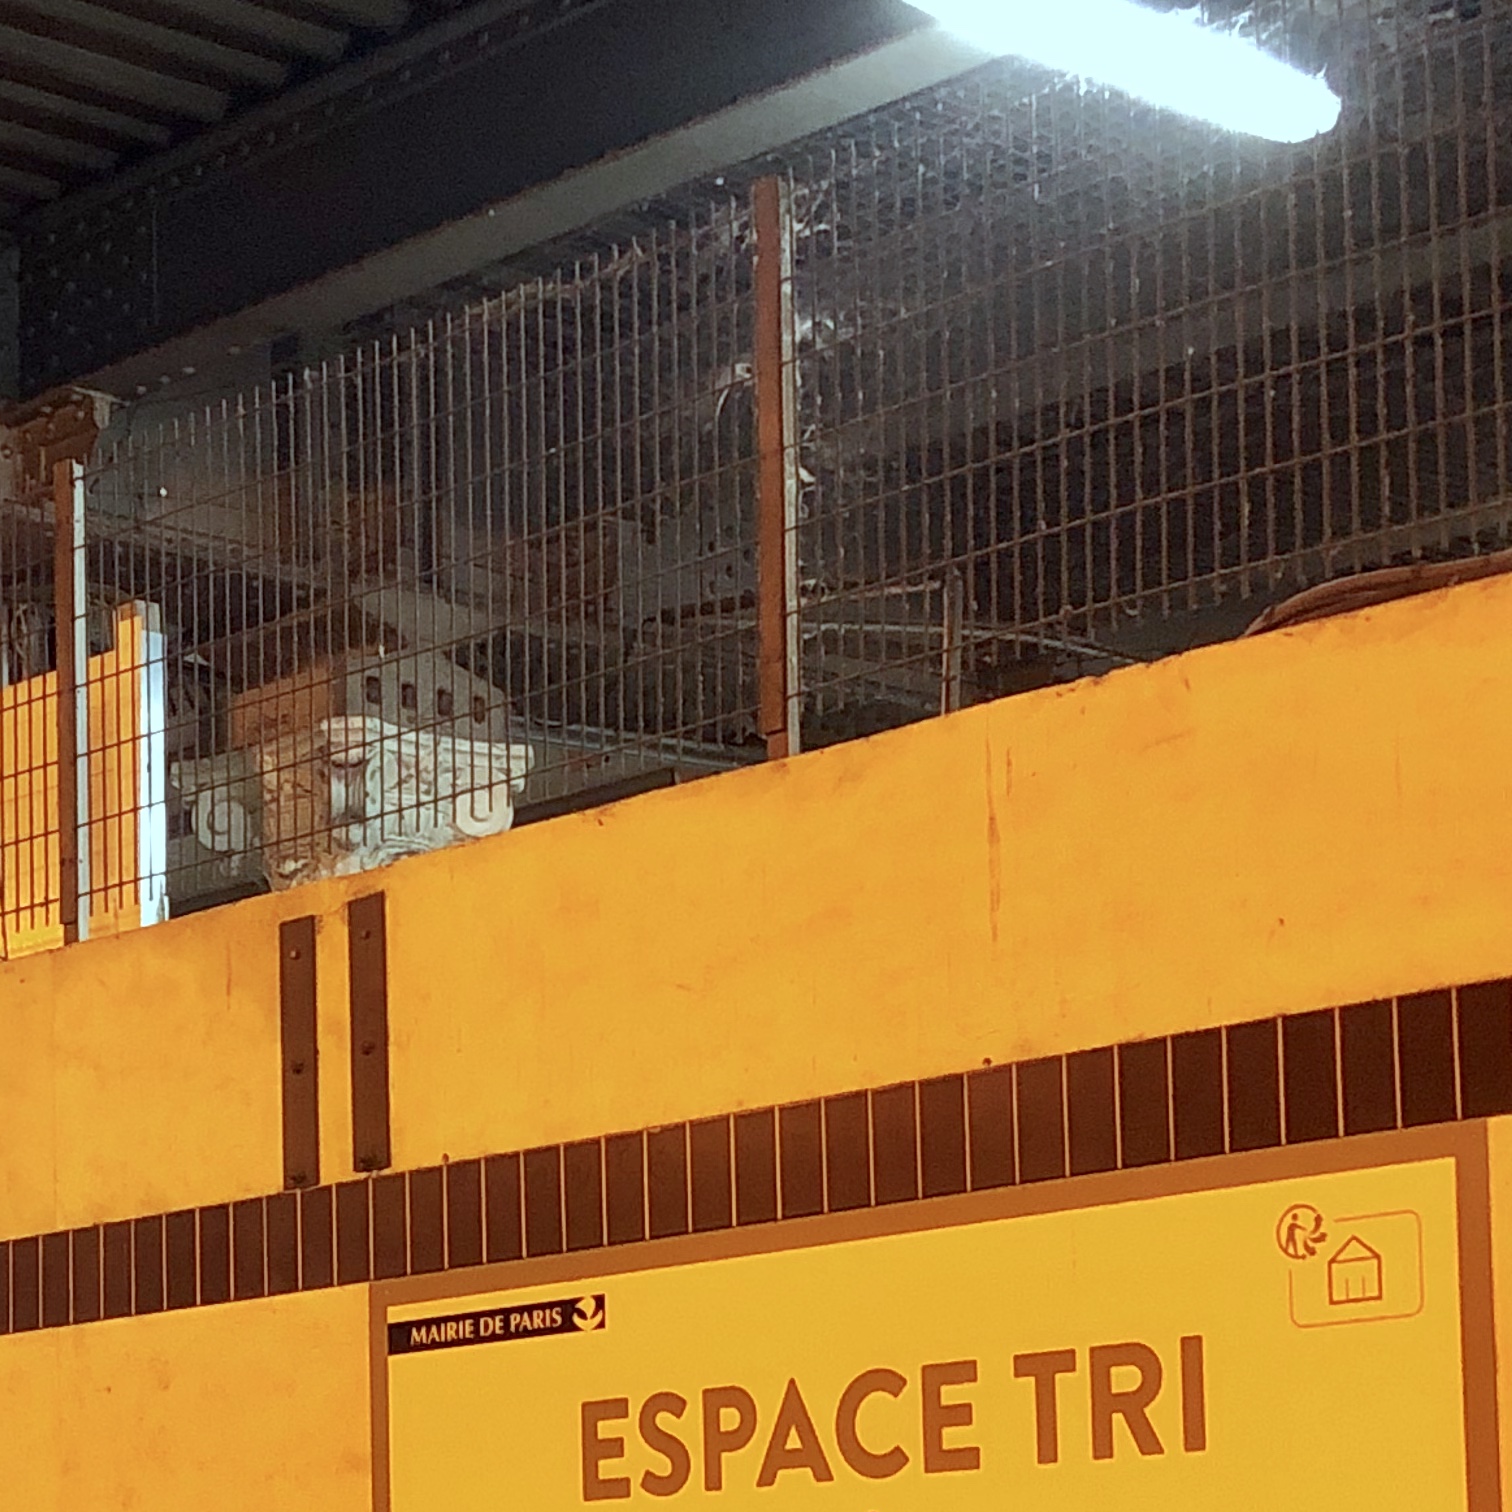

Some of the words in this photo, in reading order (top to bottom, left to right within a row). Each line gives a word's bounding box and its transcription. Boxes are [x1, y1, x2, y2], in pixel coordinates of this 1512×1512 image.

[410, 1319, 475, 1346] MAIRIE
[479, 1315, 505, 1337] DE
[509, 1307, 563, 1333] PARIS
[581, 1358, 982, 1502] ESPACE
[1012, 1334, 1207, 1465] TRI
